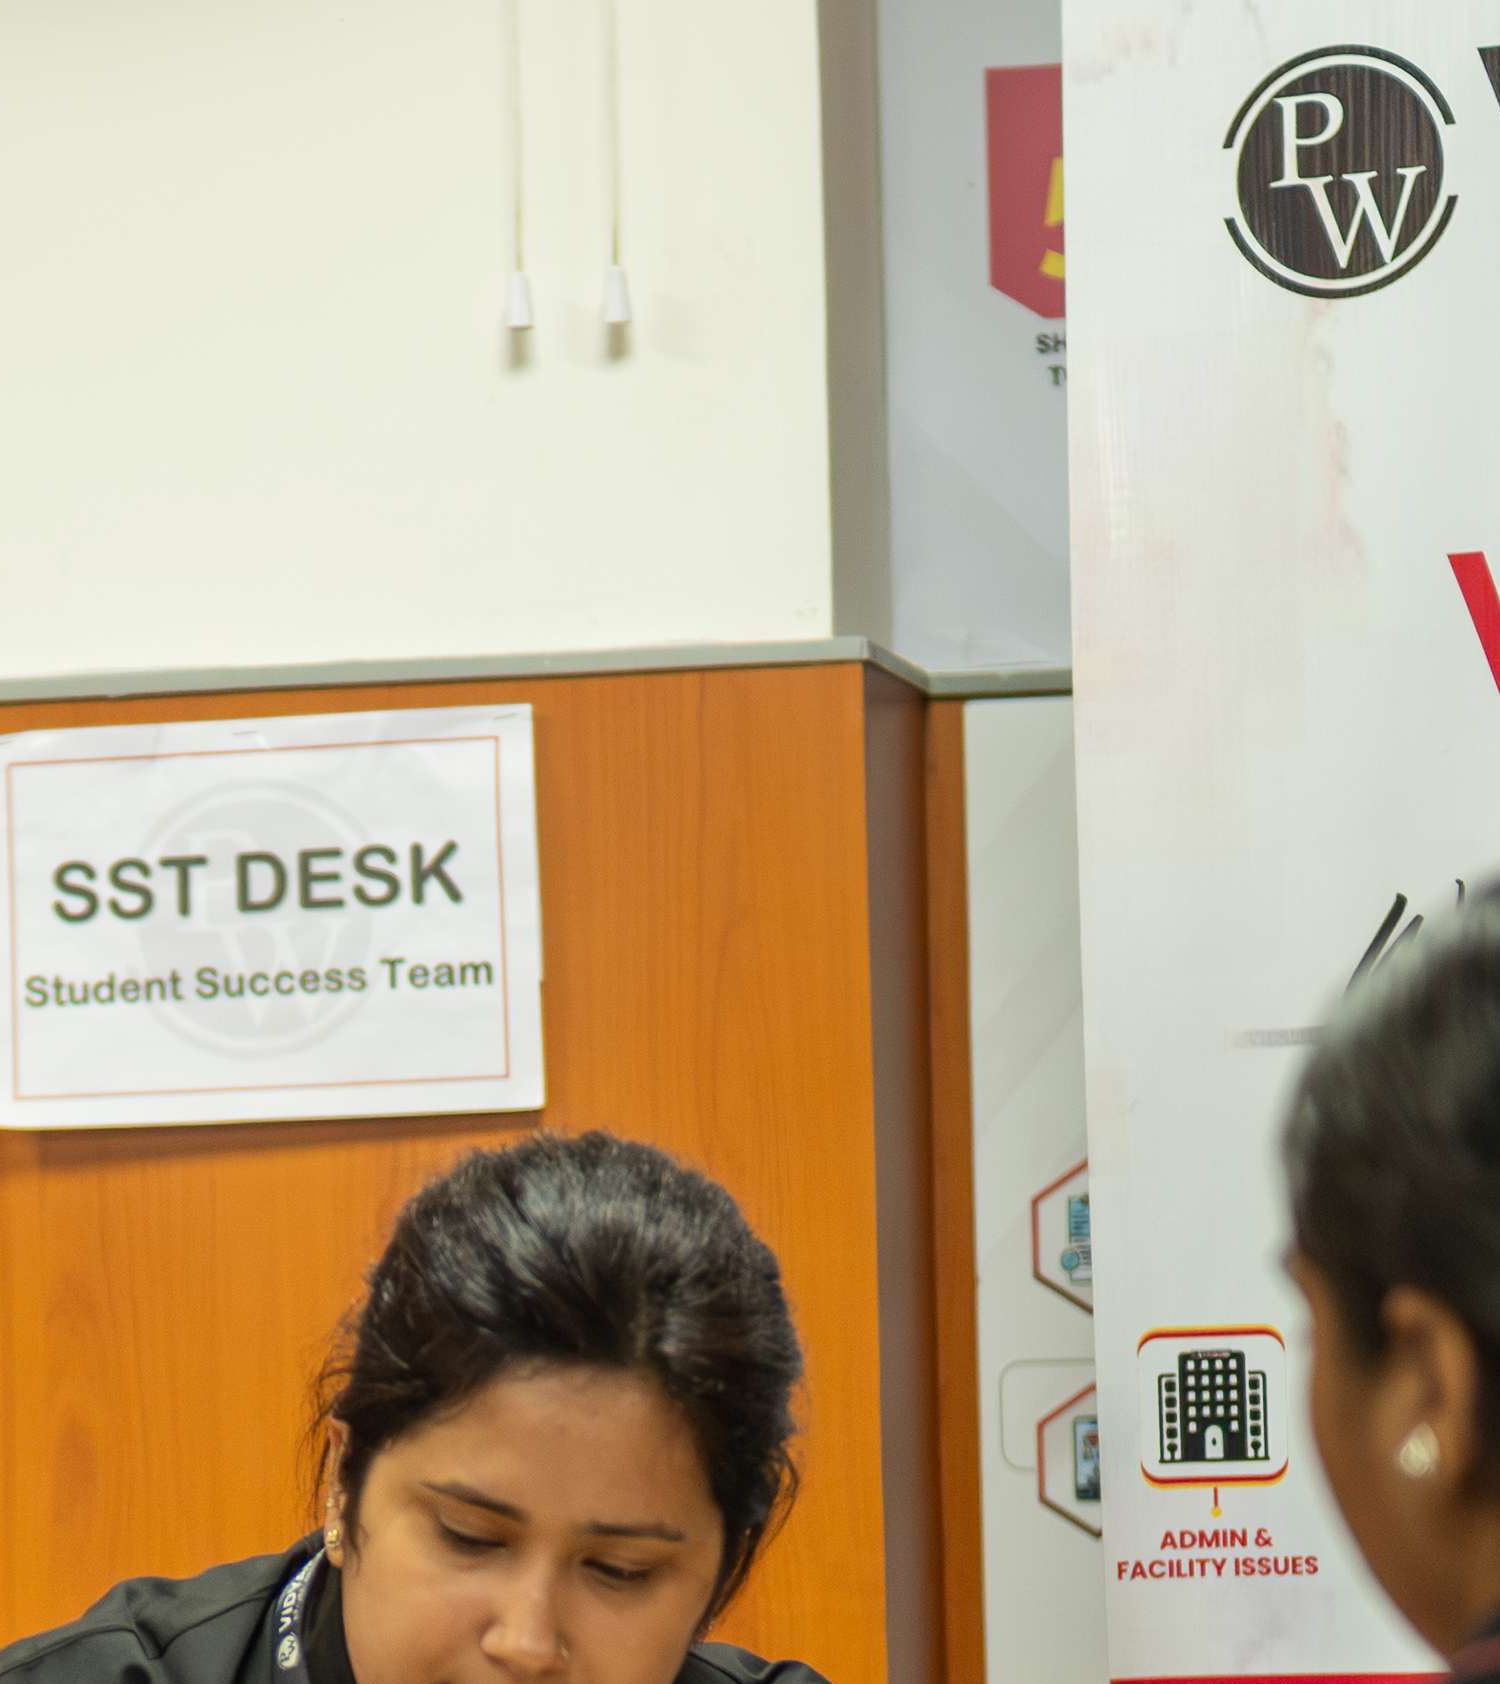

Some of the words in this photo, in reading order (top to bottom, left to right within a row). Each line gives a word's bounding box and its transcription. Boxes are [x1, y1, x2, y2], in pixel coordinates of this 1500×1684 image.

[53, 855, 208, 923] SST
[236, 840, 464, 912] DESK
[24, 967, 184, 1008] Student
[195, 963, 368, 1000] Success
[380, 956, 495, 990] Team
[1160, 1528, 1249, 1550] ADMIN
[1254, 1528, 1274, 1548] &
[1116, 1557, 1228, 1580] FACILITY
[1234, 1556, 1319, 1577] ISSUES
